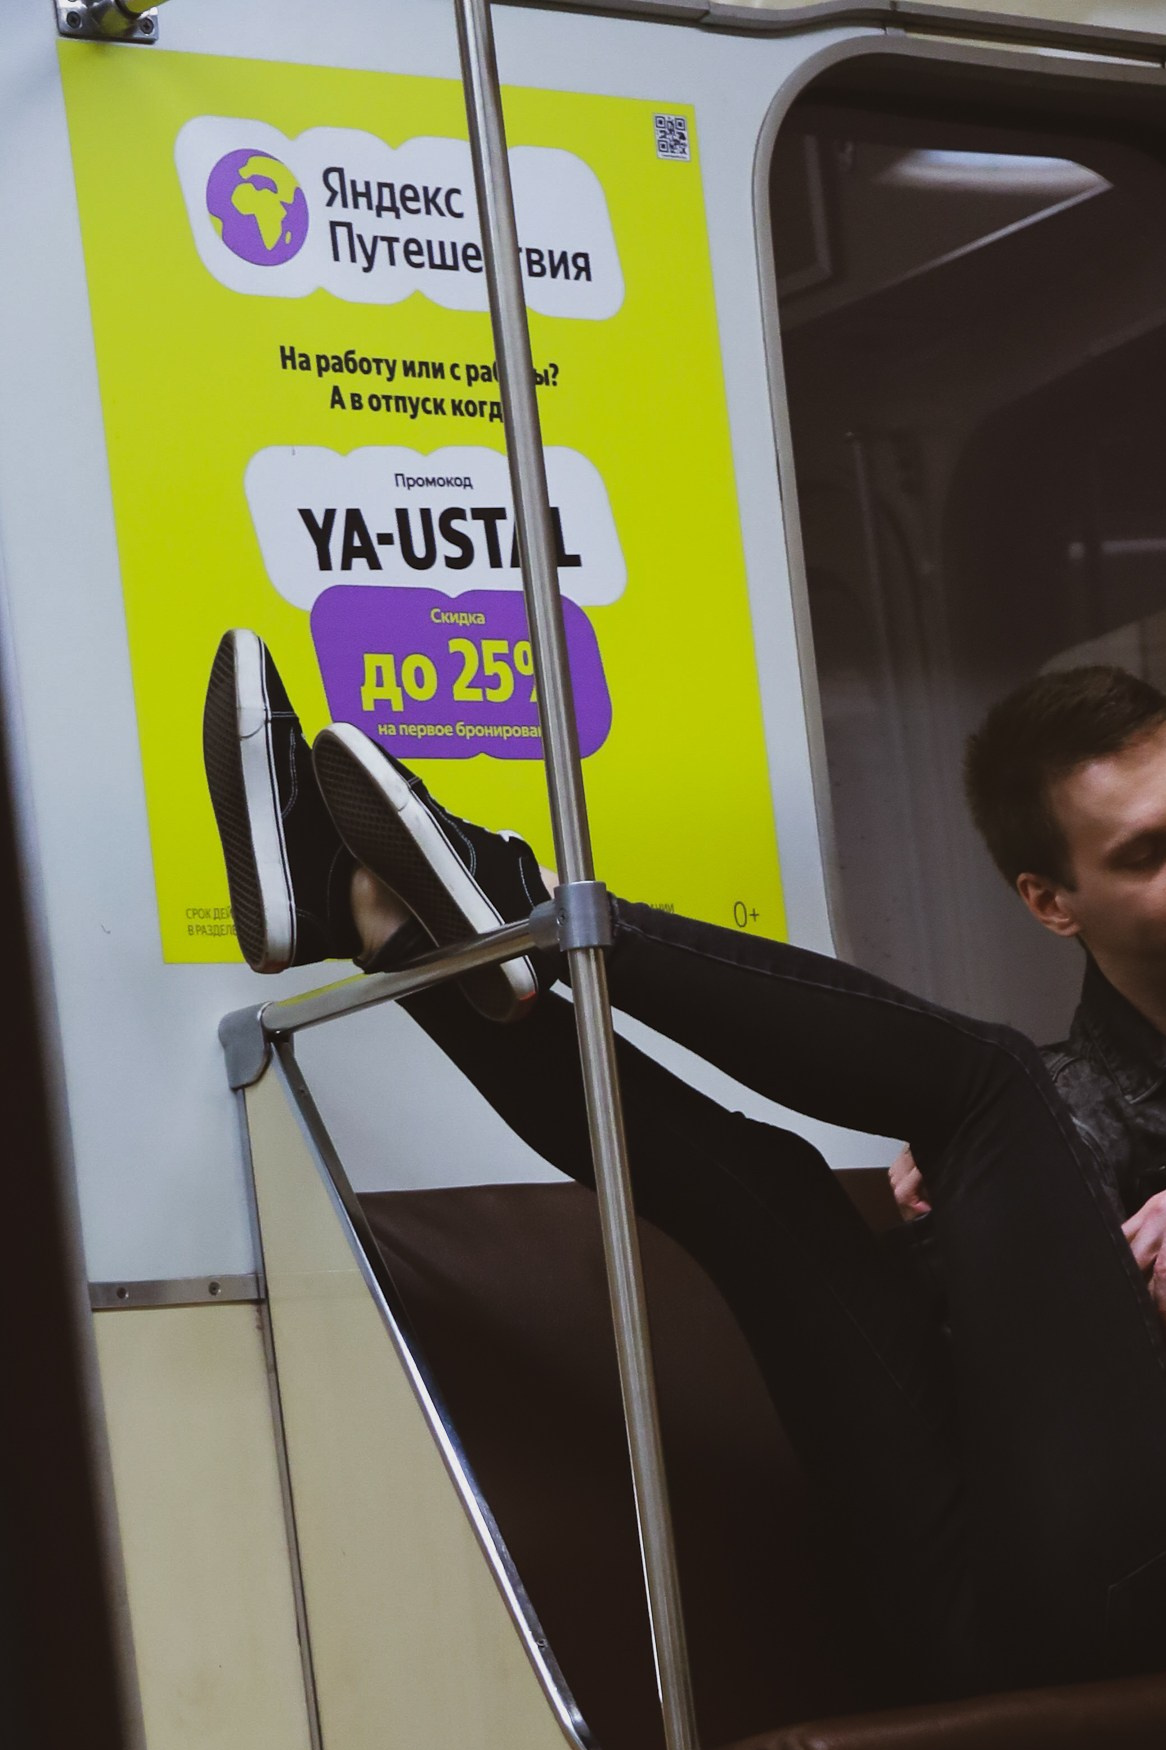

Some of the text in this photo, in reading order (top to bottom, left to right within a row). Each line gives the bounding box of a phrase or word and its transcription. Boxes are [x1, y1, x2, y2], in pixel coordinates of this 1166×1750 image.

[322, 166, 464, 219] Яндекс
[329, 220, 592, 282] Путешевия
[279, 345, 559, 387] На работу или с раы?
[330, 385, 504, 423] А в отпуск когд
[394, 473, 473, 490] Промокод
[430, 608, 486, 627] Скидка
[360, 652, 438, 712] до
[378, 724, 397, 736] на
[399, 724, 453, 739] первое
[733, 901, 760, 928] 0+
